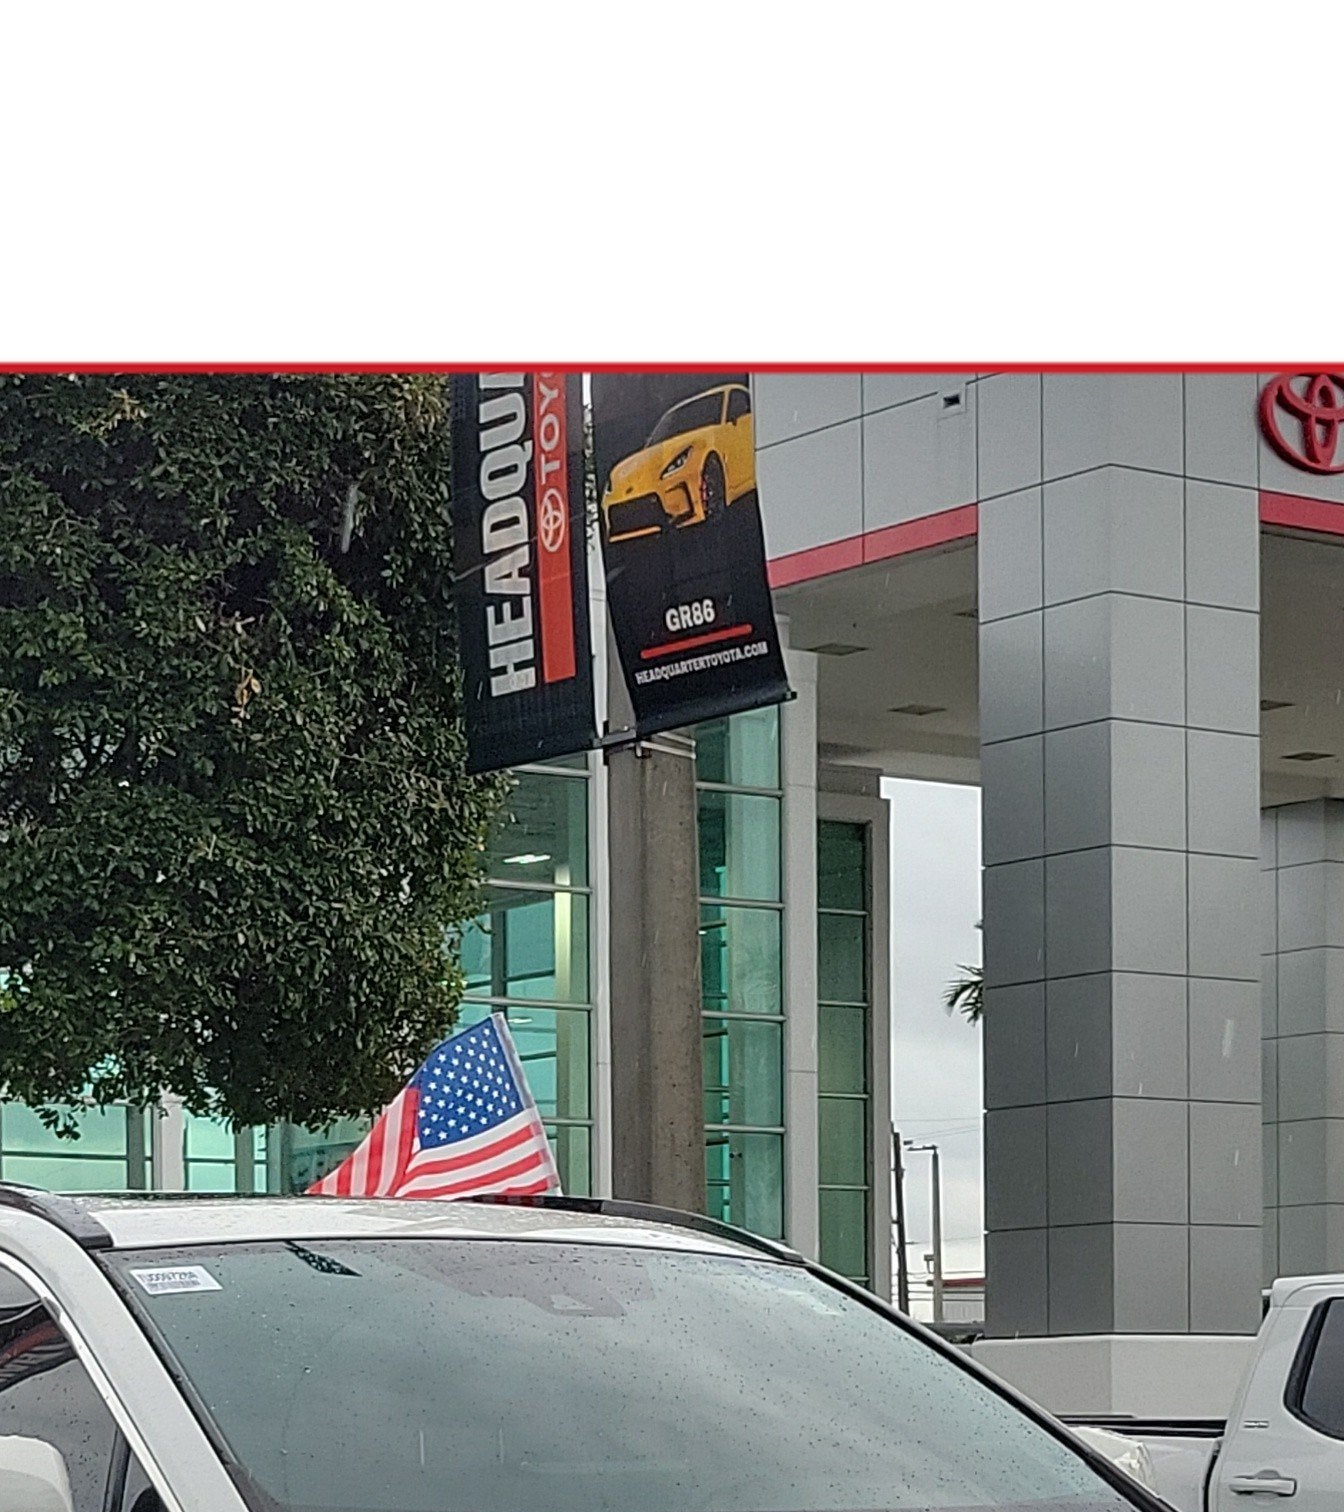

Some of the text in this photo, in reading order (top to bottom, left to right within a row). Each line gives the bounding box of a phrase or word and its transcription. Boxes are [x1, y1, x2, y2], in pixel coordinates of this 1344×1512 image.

[539, 373, 561, 486] TOY
[665, 598, 716, 632] GR86
[635, 640, 769, 685] HEADQUARTERTOYOTA.COM
